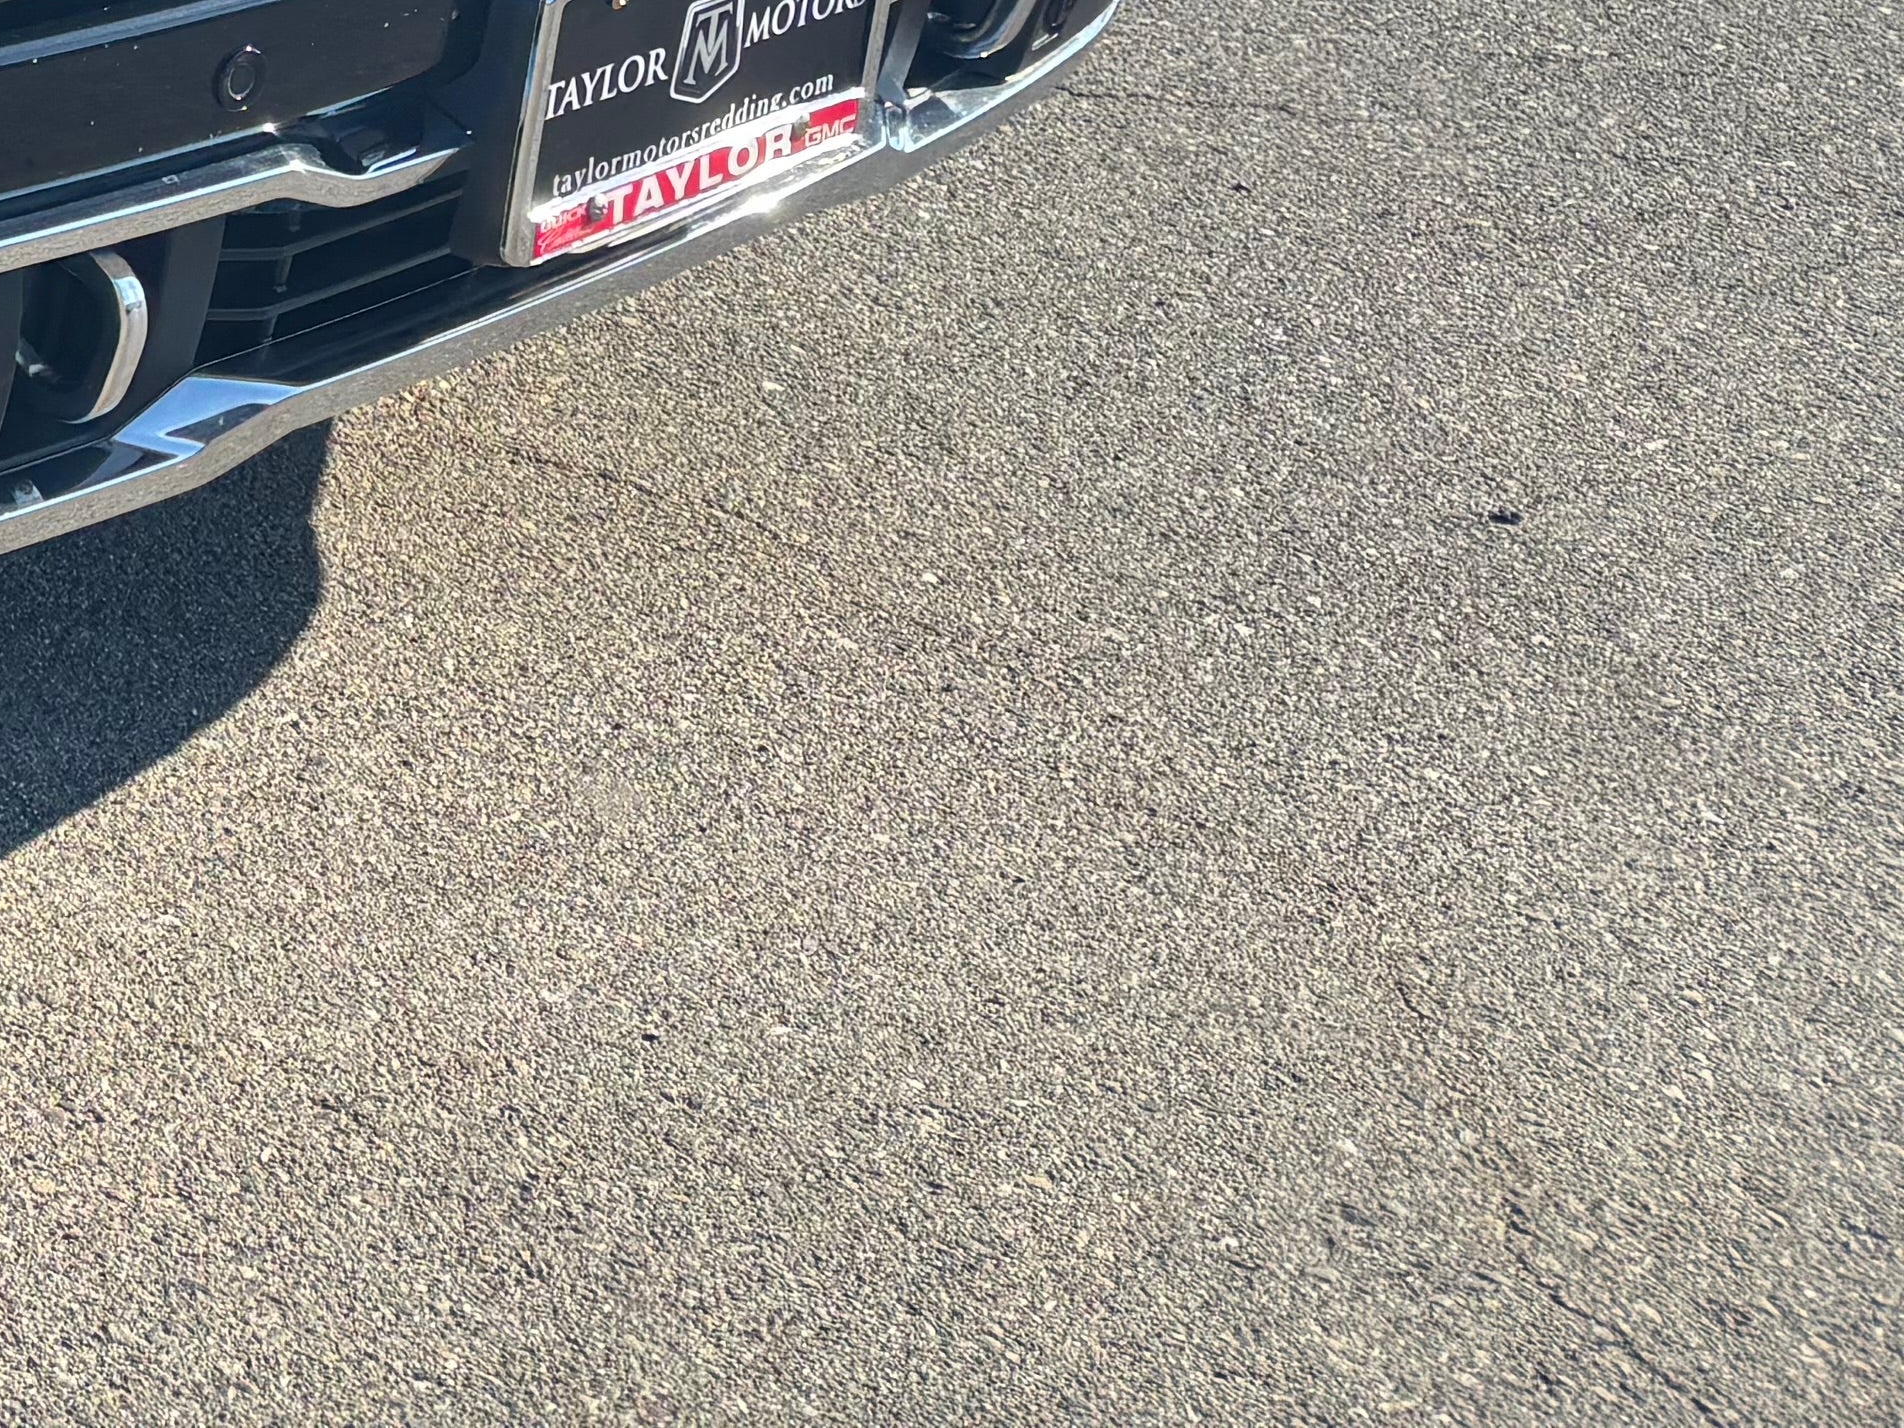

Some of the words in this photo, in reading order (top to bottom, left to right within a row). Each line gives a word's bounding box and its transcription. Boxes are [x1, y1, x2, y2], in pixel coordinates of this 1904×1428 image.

[544, 47, 669, 121] TAYLOR
[552, 72, 835, 196] taylormotorsredding.com
[606, 123, 793, 225] TAYLOR
[804, 114, 858, 148] GMC
